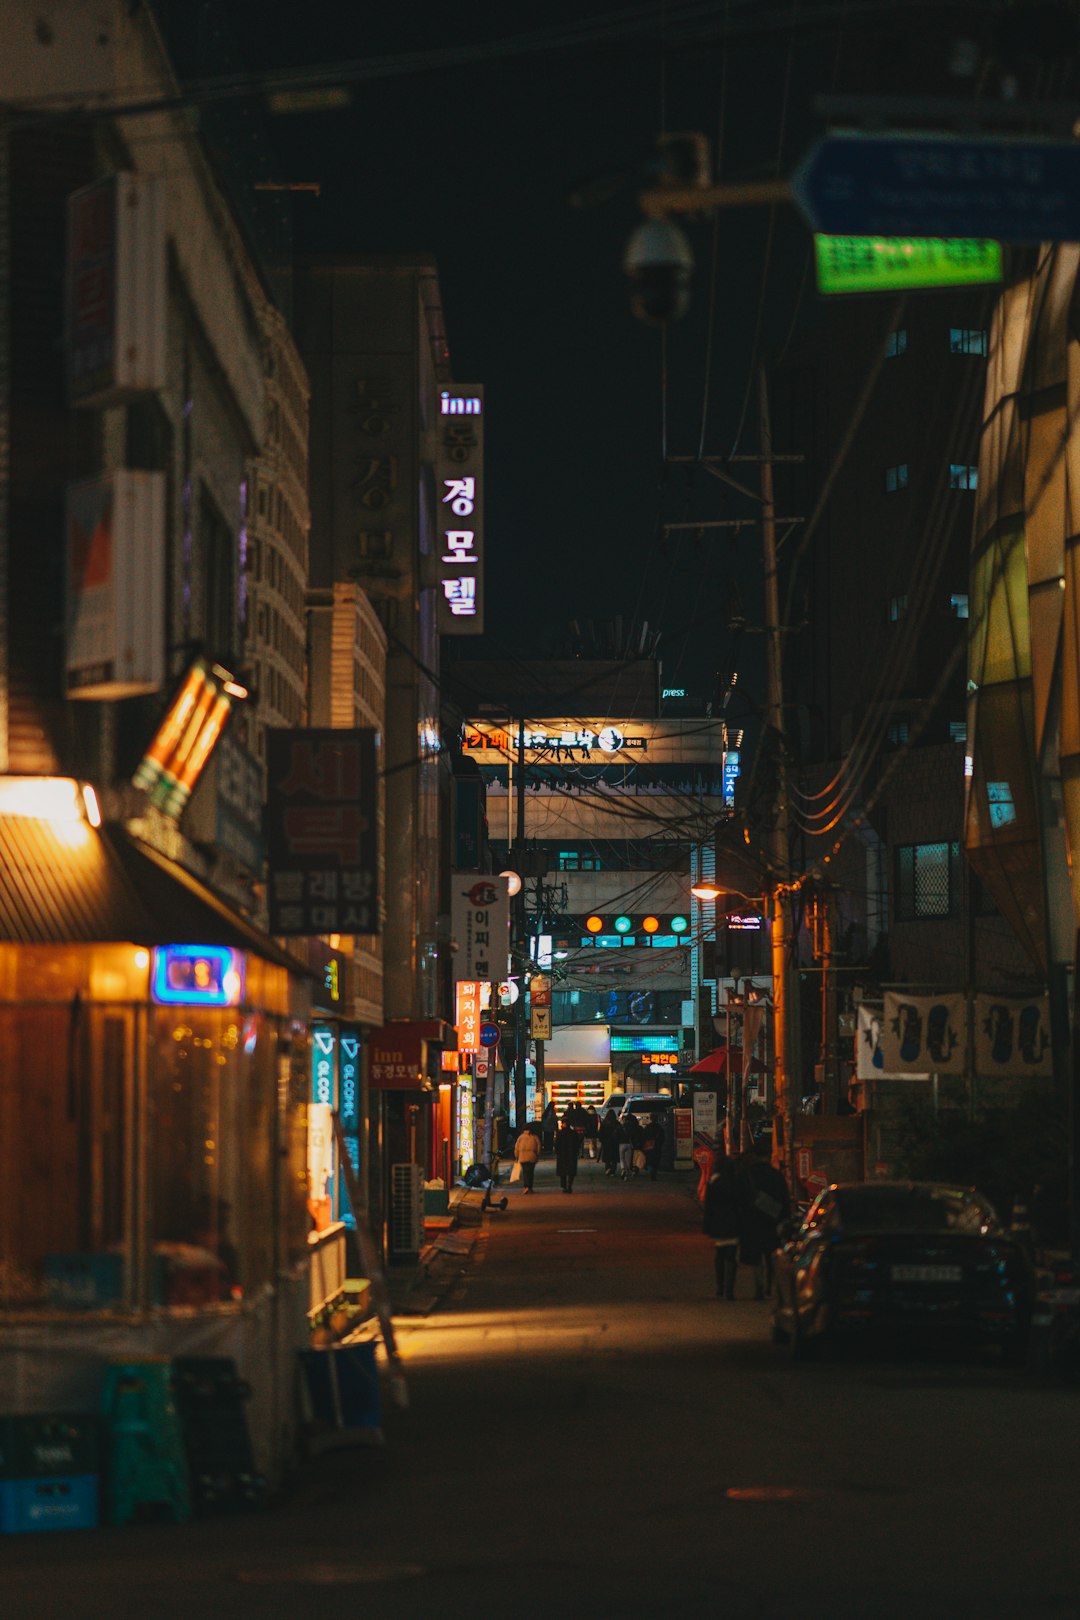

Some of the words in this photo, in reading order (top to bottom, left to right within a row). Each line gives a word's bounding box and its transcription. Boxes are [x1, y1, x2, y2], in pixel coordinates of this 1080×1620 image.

[440, 391, 482, 415] inn
[440, 421, 479, 616] 동경모텔
[662, 688, 685, 698] press
[277, 739, 370, 867] 세탁
[462, 983, 476, 1046] 돼지상회
[373, 1048, 404, 1063] inn
